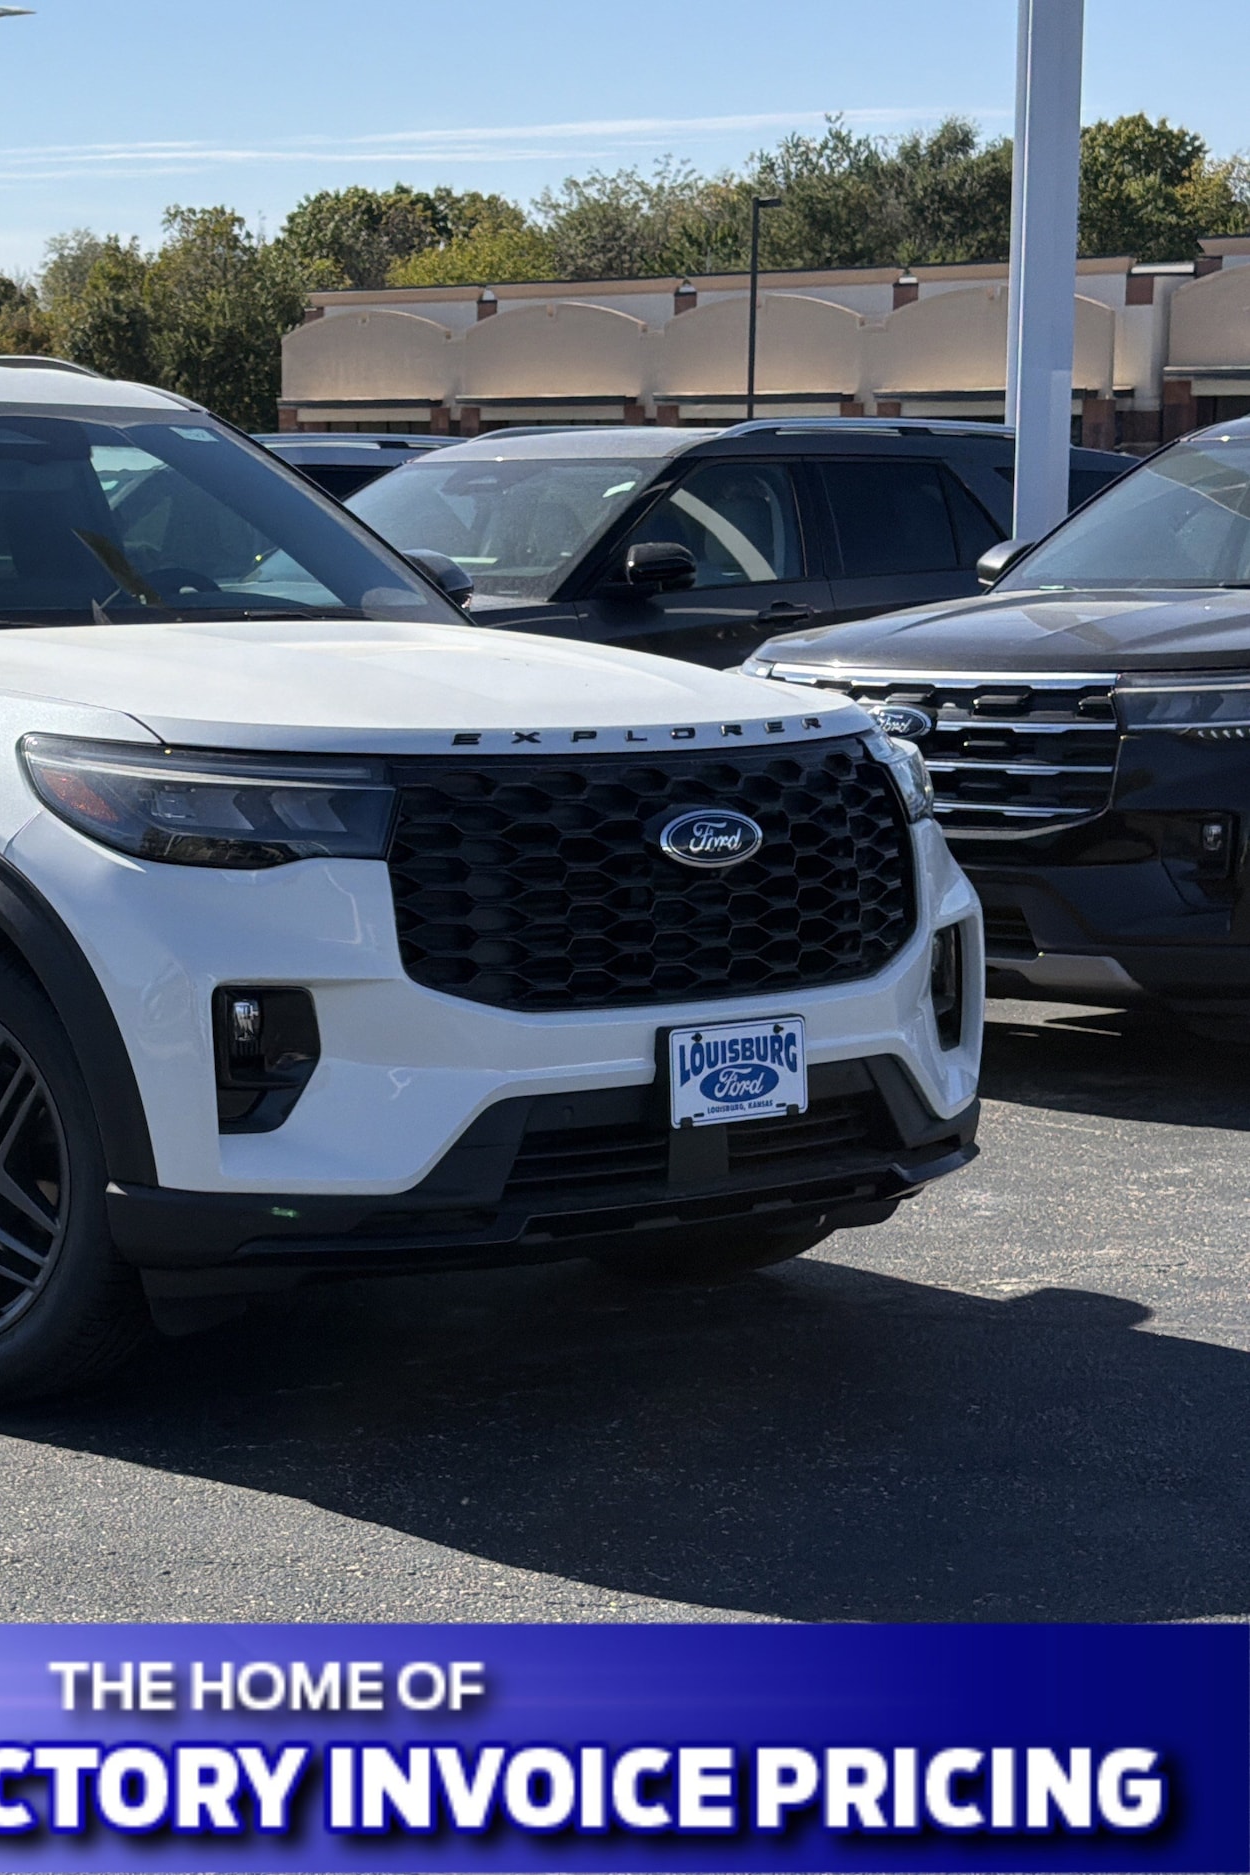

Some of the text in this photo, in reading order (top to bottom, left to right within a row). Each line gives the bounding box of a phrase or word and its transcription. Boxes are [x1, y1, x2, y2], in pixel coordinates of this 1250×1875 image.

[451, 716, 822, 746] EXPLORER
[688, 821, 743, 854] Ford
[679, 1031, 798, 1088] LOUISBURG
[714, 1067, 765, 1098] Ford
